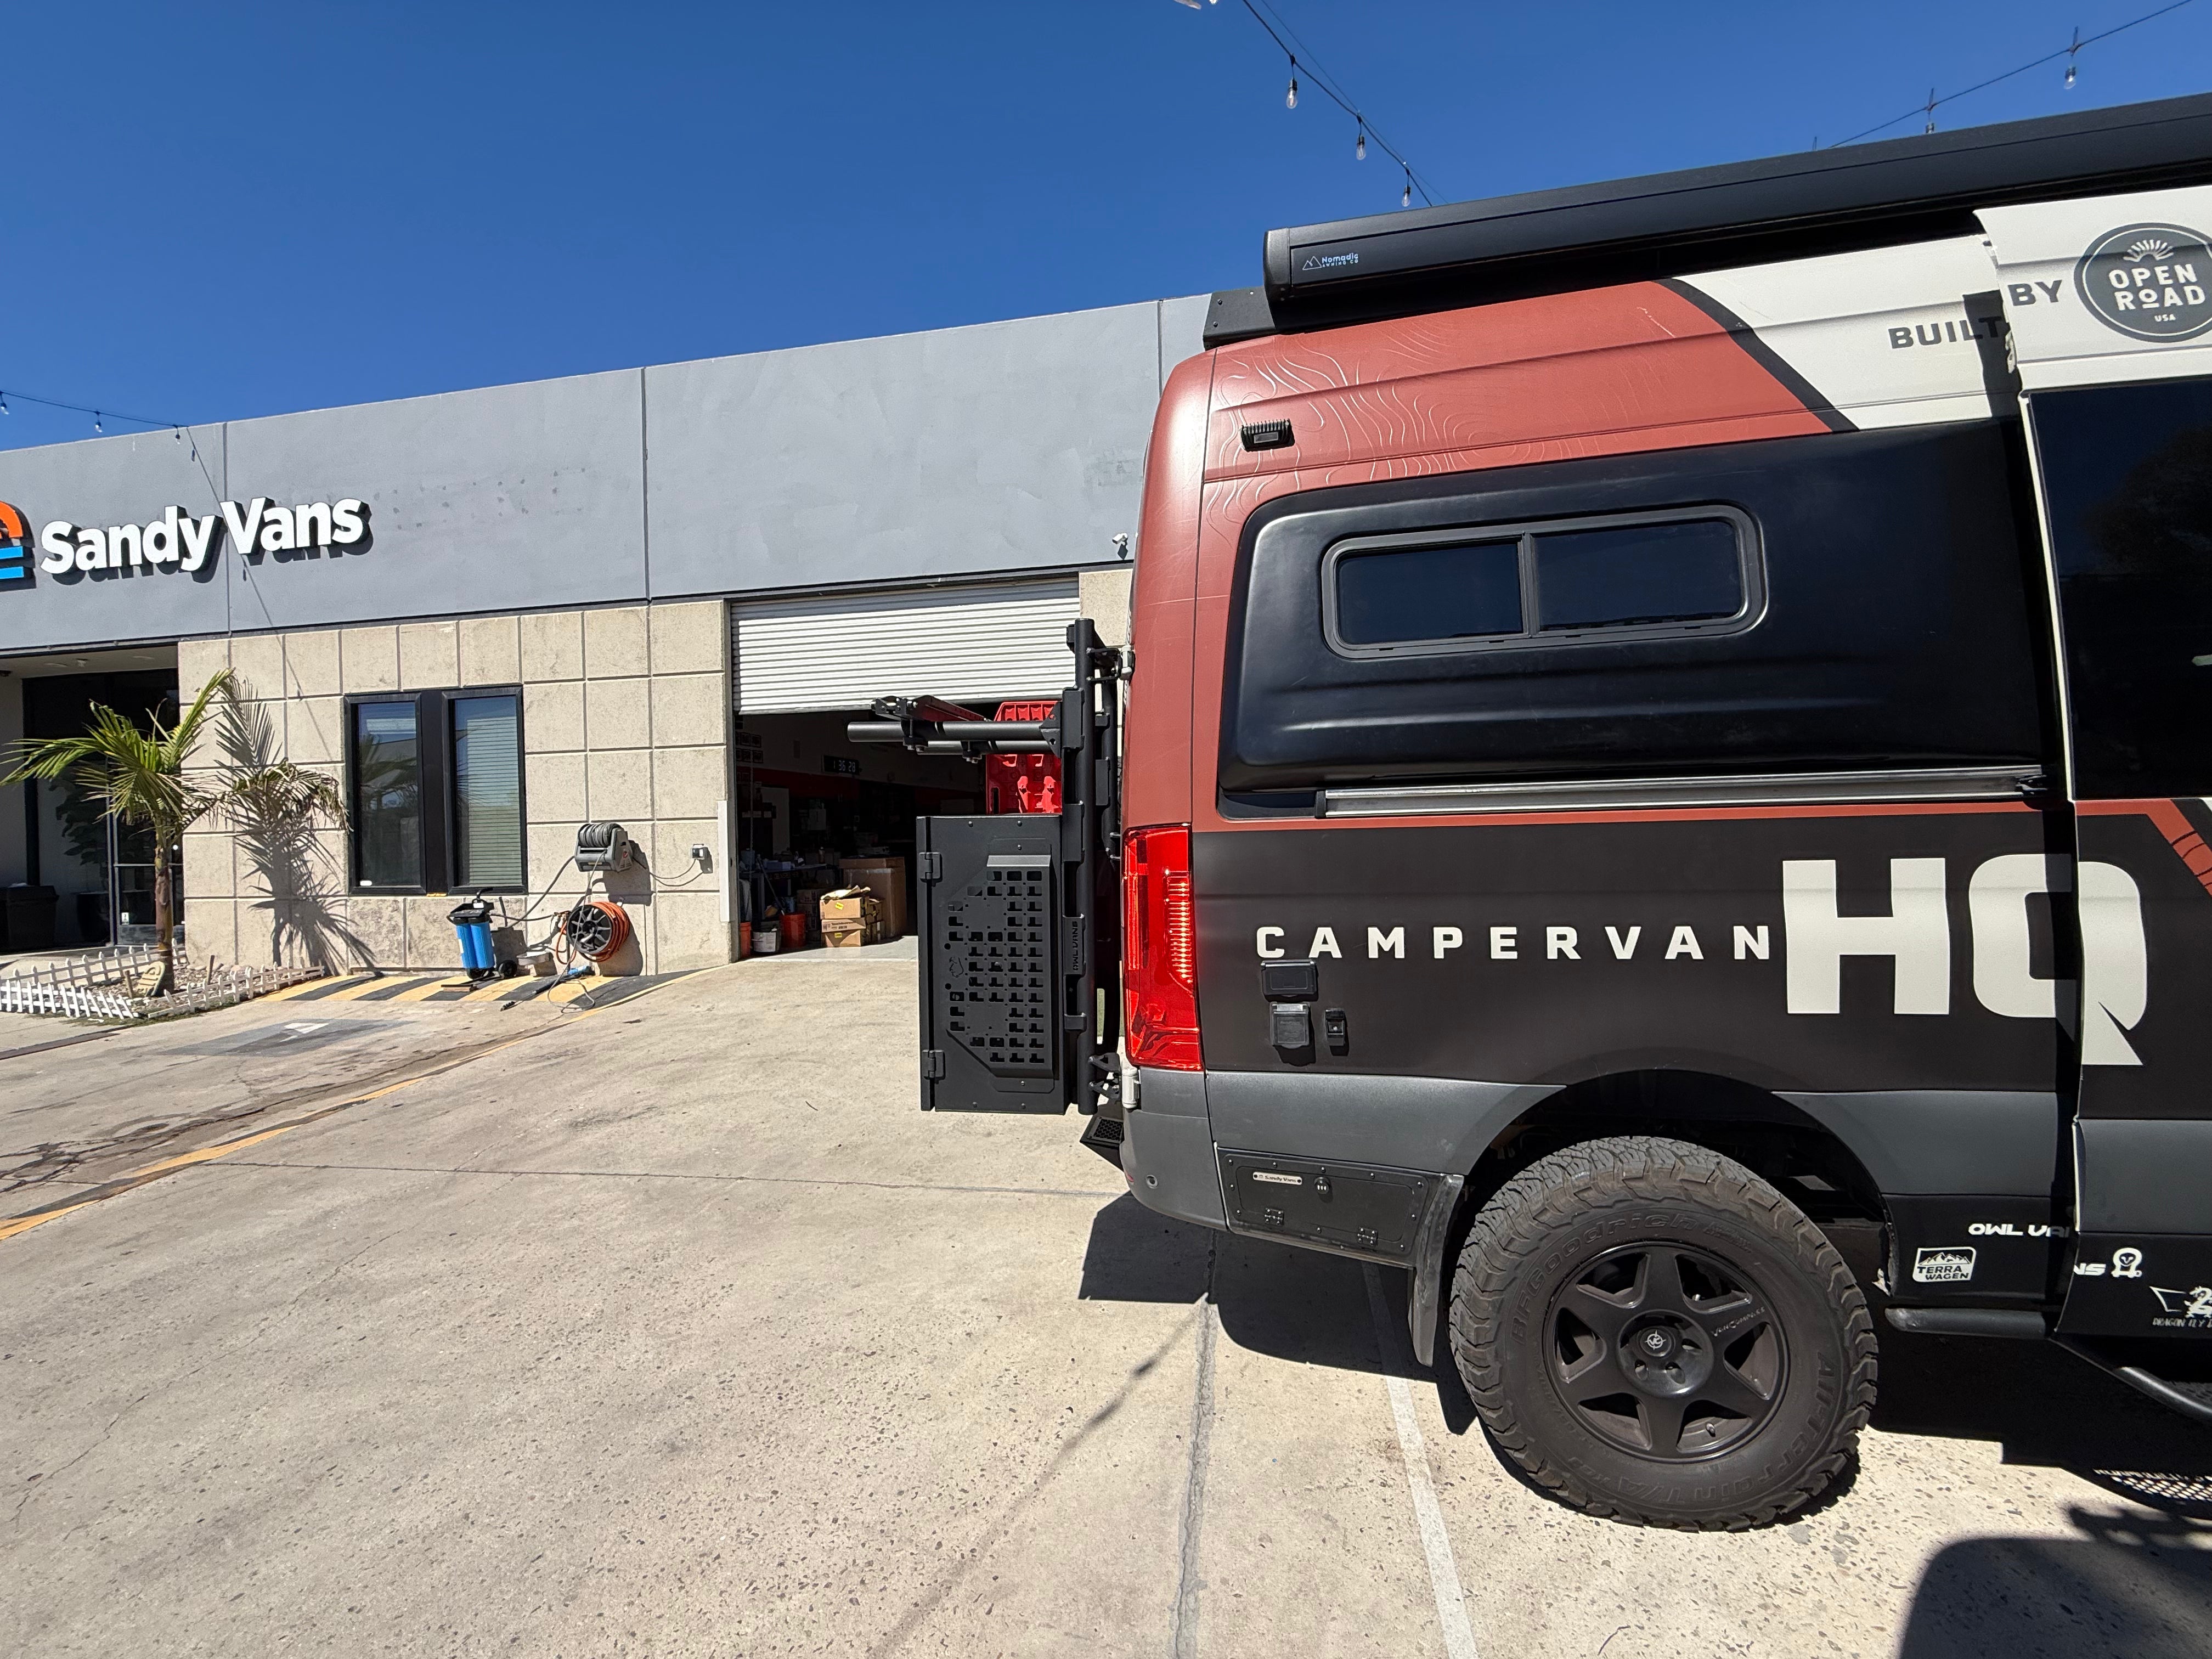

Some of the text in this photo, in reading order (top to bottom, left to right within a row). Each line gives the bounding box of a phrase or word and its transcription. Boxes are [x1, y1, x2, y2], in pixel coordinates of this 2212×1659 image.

[1322, 252, 1359, 263] Nomadic
[2109, 263, 2197, 289] OPEN
[2114, 285, 2206, 312] ROAD
[1888, 279, 2062, 349] BUILT BY
[2154, 313, 2176, 323] USA
[41, 496, 369, 574] Sandy Vans
[1256, 854, 2147, 1065] CAMPERVAN HQ
[1968, 1223, 2024, 1236] OWL
[1510, 1212, 1699, 1345] BFGoodrich
[1917, 1265, 1962, 1275] TERRA
[1925, 1272, 1970, 1280] WAGEN
